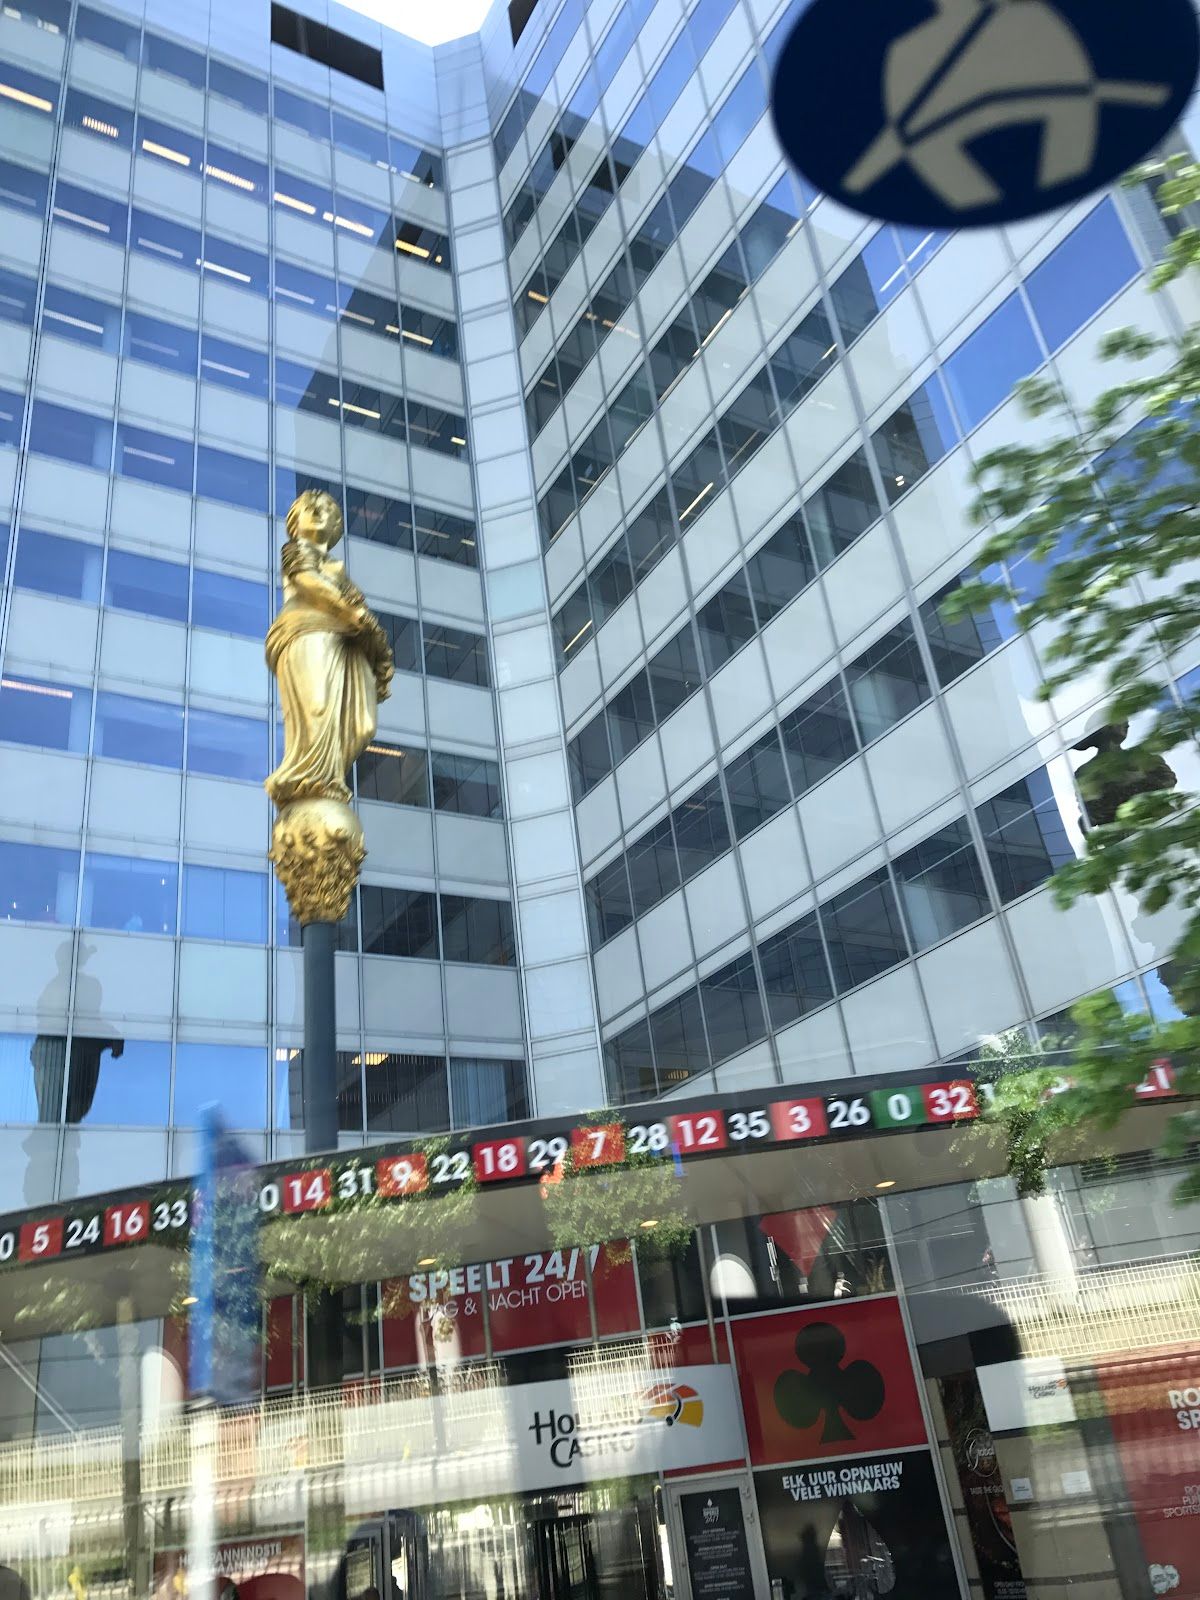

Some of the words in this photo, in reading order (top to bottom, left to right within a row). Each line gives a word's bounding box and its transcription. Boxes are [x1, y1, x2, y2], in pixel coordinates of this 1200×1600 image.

[32, 1224, 50, 1254] 5
[65, 1215, 100, 1249] 24
[111, 1207, 144, 1239] 16
[153, 1199, 188, 1231] 33
[289, 1175, 325, 1207] 14
[338, 1167, 373, 1199] 31
[391, 1160, 413, 1189] 9
[431, 1151, 470, 1183] 22
[480, 1143, 518, 1174] 18
[528, 1136, 568, 1168] 29
[587, 1131, 607, 1160] 7
[628, 1123, 669, 1154] 28
[678, 1116, 719, 1147] 12
[728, 1110, 771, 1141] 35
[788, 1105, 811, 1133] 3
[827, 1098, 871, 1128] 26
[888, 1093, 912, 1121] 0
[929, 1086, 974, 1116] 32
[408, 1258, 514, 1303] SPEELT
[524, 1244, 600, 1285] 24/7
[464, 1297, 477, 1316] &
[488, 1286, 541, 1312] NACHT
[546, 1279, 589, 1303] OPEN
[1168, 1387, 1200, 1409] RO
[1176, 1409, 1200, 1430] SP
[782, 1473, 806, 1489] ELK
[808, 1470, 836, 1486] UUR
[839, 1461, 903, 1482] OPNIEUW
[790, 1485, 822, 1501] VELE
[824, 1476, 901, 1497] WINNAARS
[1163, 1504, 1200, 1518] SPORTS
